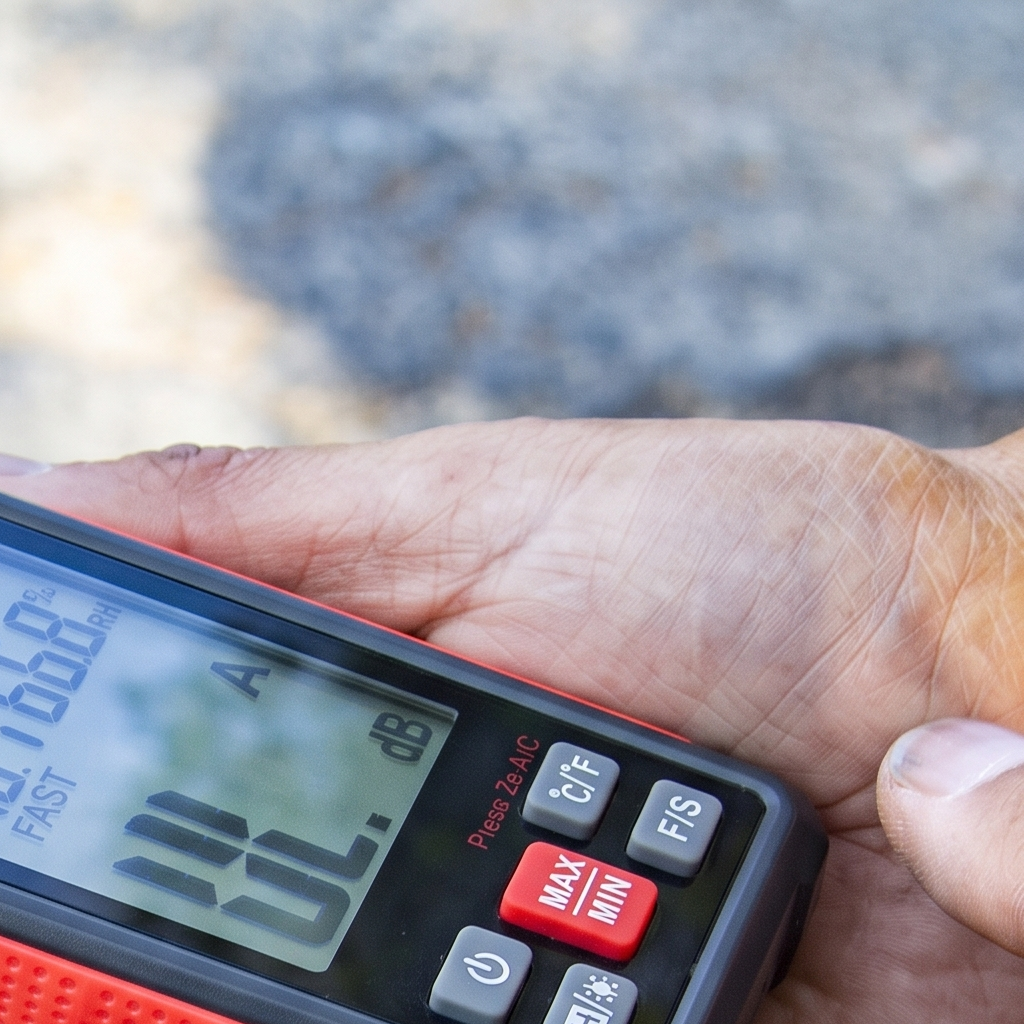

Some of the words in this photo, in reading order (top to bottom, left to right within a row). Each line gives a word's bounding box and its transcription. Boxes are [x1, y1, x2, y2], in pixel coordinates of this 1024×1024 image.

[89, 598, 122, 631] RH
[210, 660, 271, 699] A
[369, 711, 433, 763] dB
[11, 766, 78, 841] FAST
[657, 795, 702, 842] F/S
[538, 853, 586, 910] MAX
[587, 874, 633, 926] MIN
